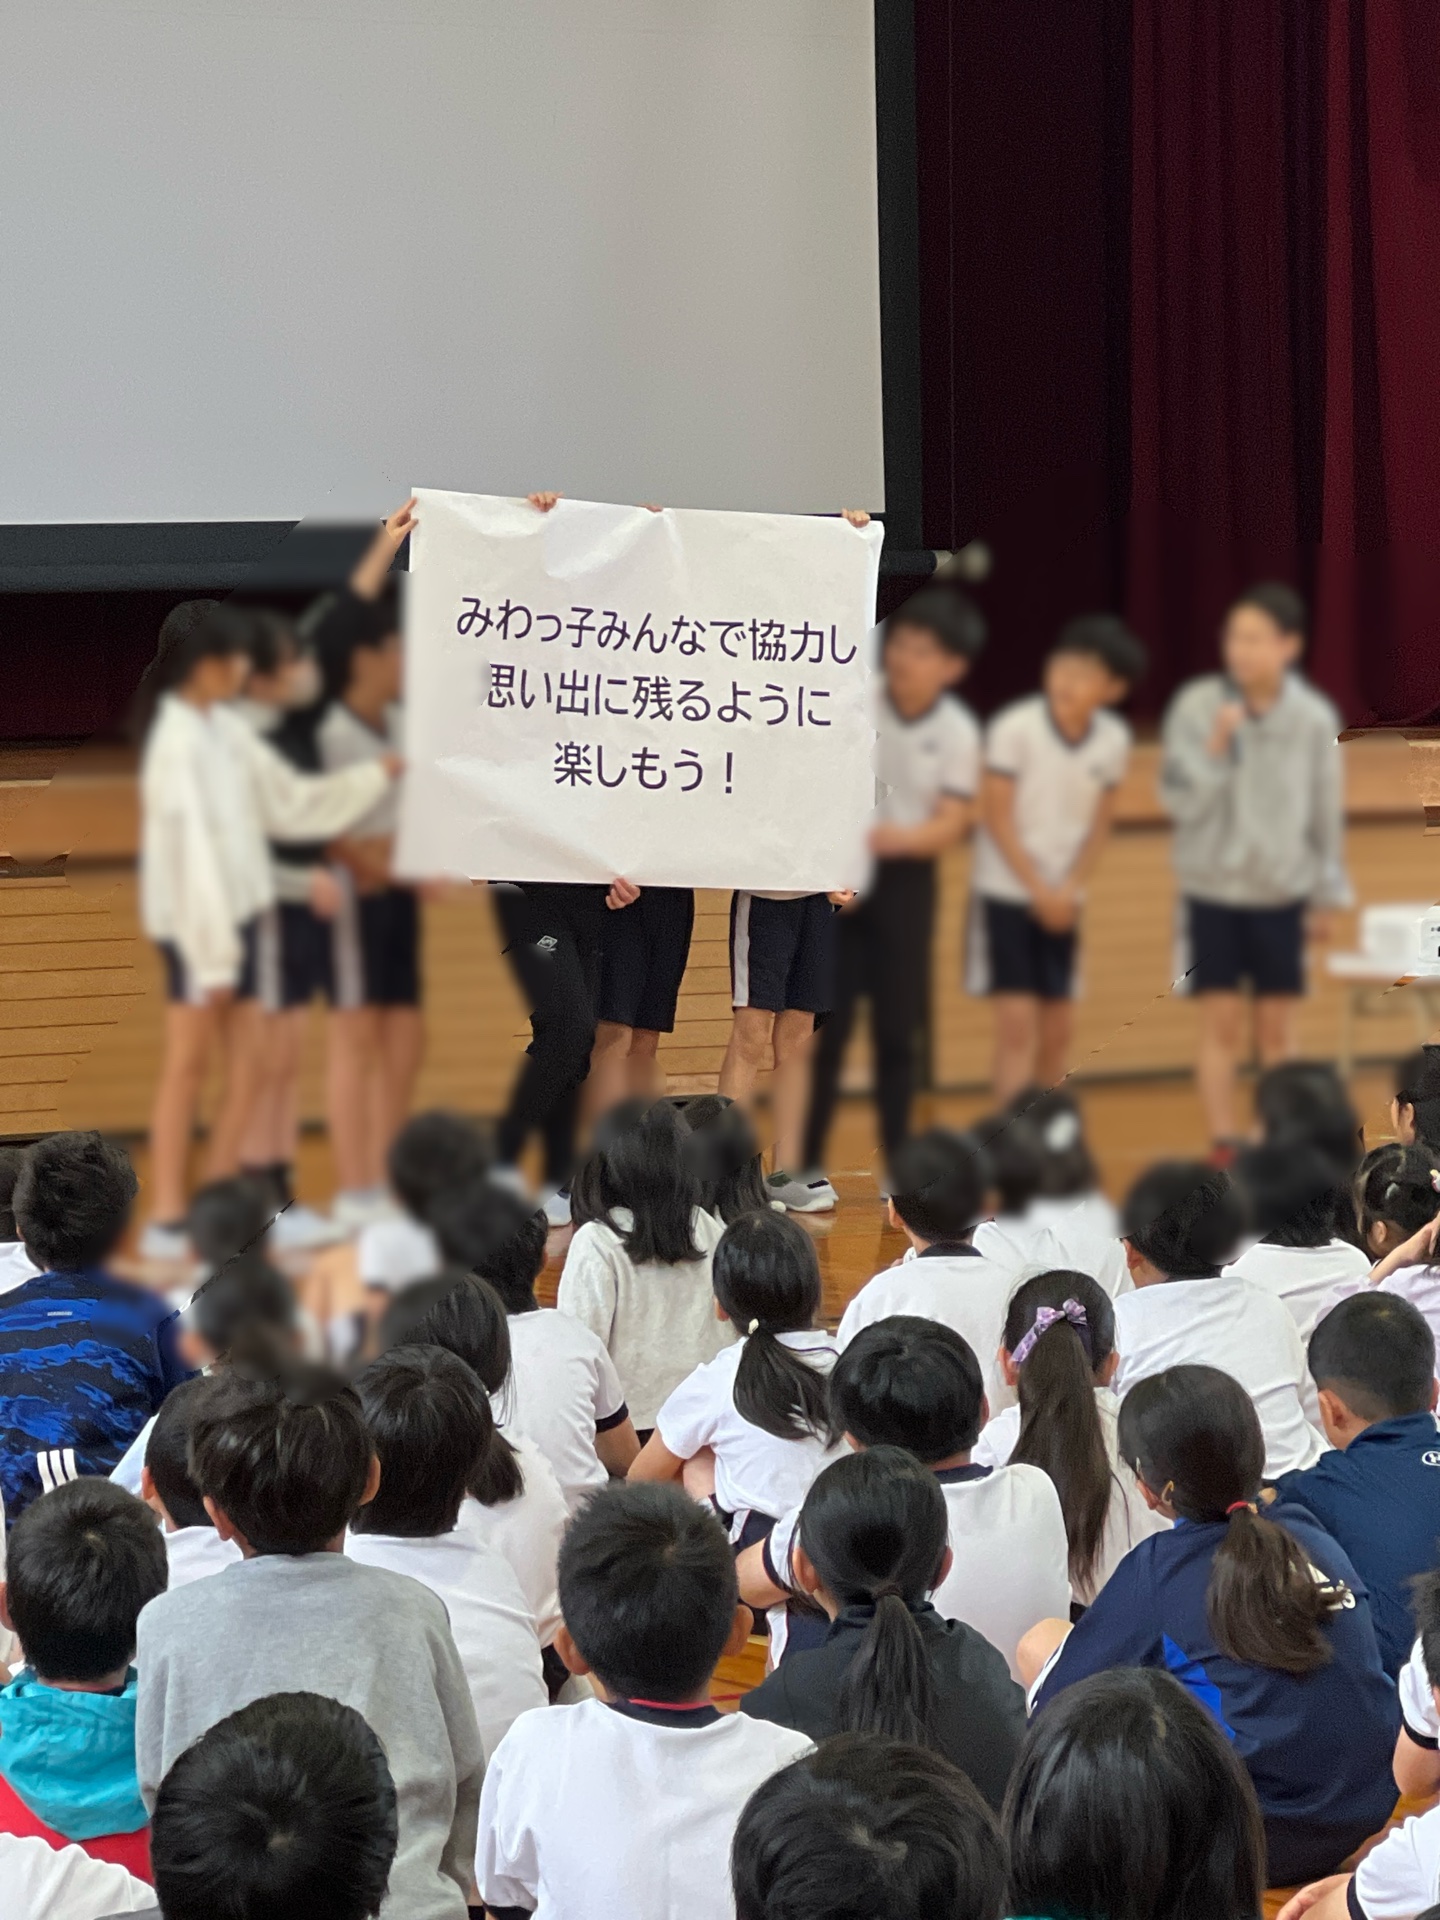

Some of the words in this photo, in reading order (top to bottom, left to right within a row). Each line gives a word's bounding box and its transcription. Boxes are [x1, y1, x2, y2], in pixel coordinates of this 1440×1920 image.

[456, 596, 857, 664] みわっ子みんなで協力し
[487, 663, 832, 727] 思い出に残るように
[554, 741, 733, 793] 楽しもう！
